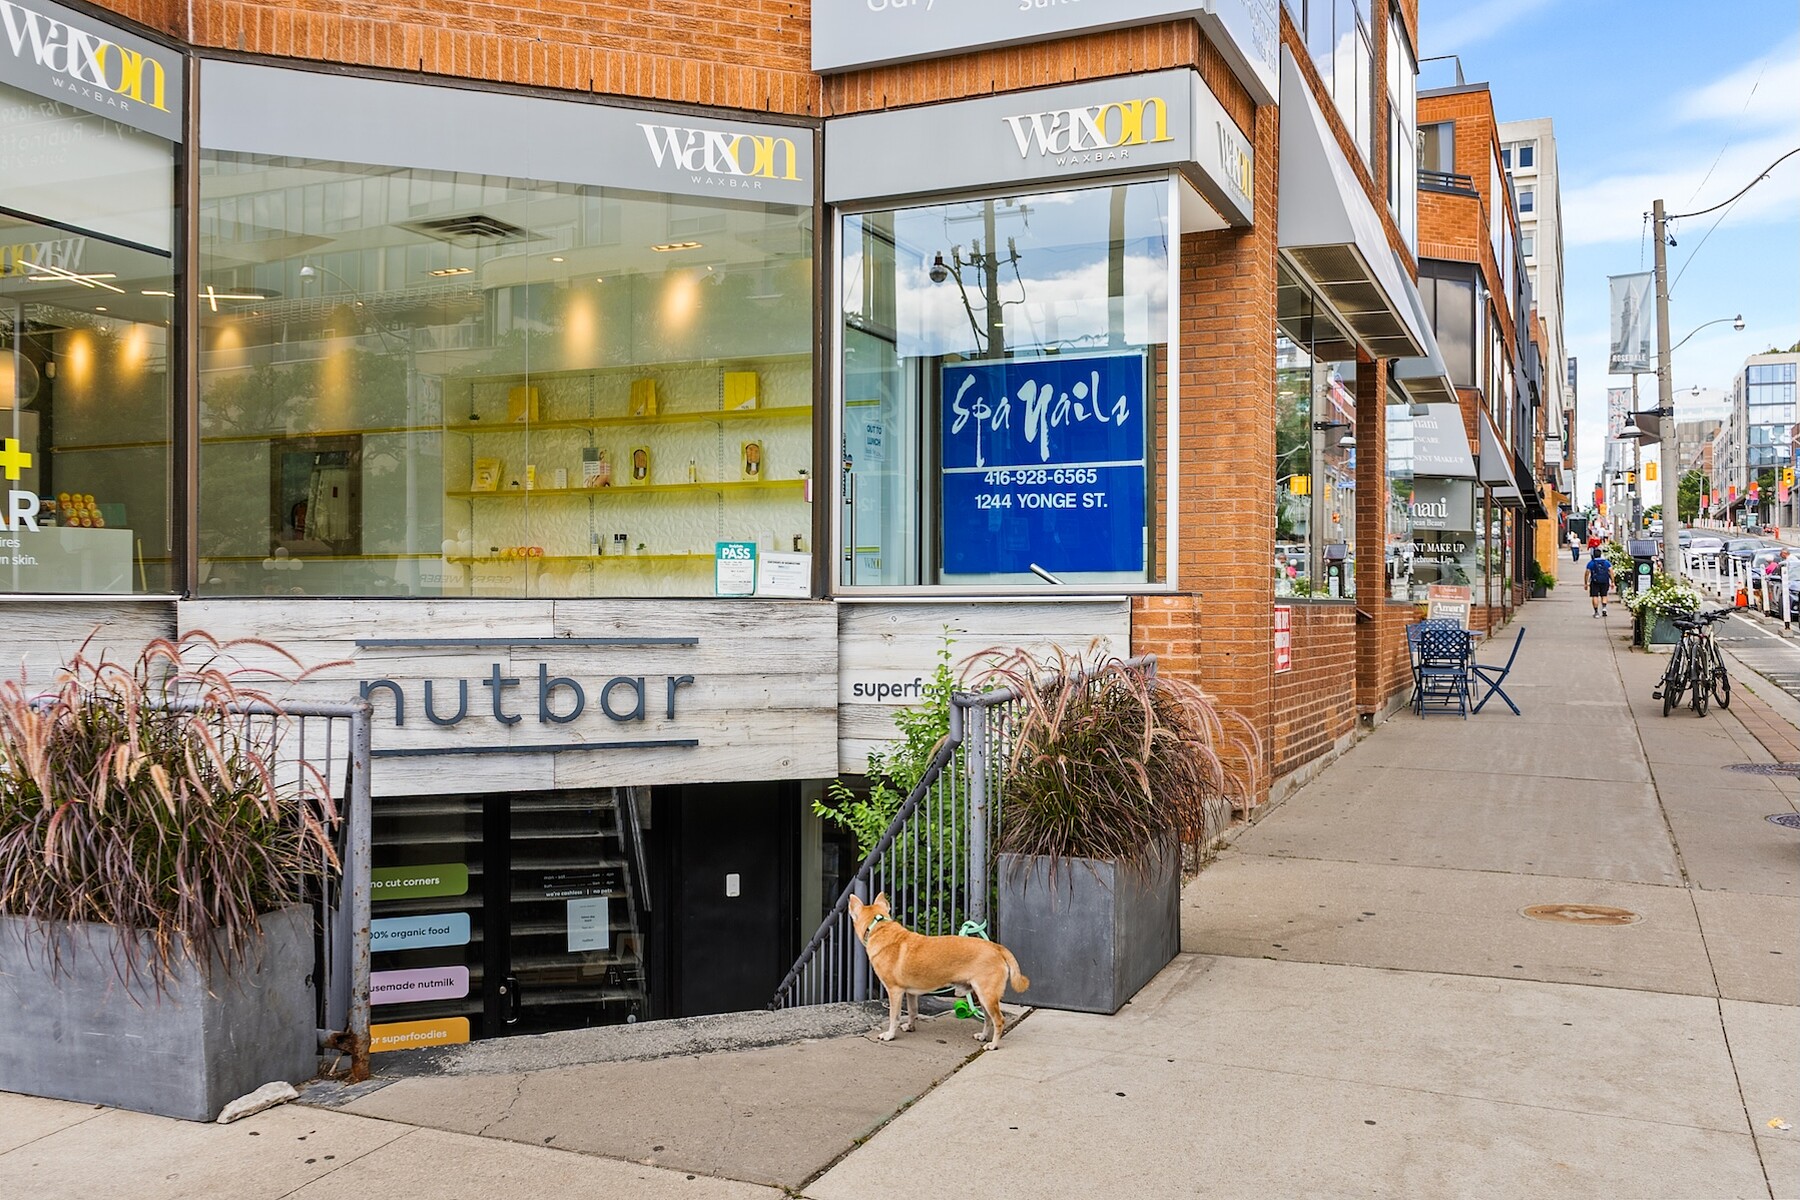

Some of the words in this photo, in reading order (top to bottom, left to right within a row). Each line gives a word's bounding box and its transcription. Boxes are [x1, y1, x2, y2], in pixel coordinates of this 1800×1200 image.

[52, 76, 130, 111] WAXBAR
[1056, 150, 1129, 166] WAXBAR
[691, 175, 762, 189] WAXBAR
[1612, 354, 1646, 363] ROSEDALE
[951, 374, 1010, 467] Spa
[1017, 371, 1130, 462] Nails
[867, 424, 876, 434] OUT
[876, 425, 882, 435] TO
[867, 437, 882, 446] LUNCH
[984, 469, 1097, 485] 416-928-6565
[975, 494, 1012, 509] 1244
[1017, 493, 1076, 508] YONGE
[1083, 493, 1108, 508] ST.
[722, 547, 751, 559] PASS
[1427, 542, 1452, 553] MAKE
[1453, 543, 1465, 553] UP
[12, 554, 38, 566] skin.
[360, 664, 694, 726] nutbar
[853, 677, 960, 701] superfoo
[370, 881, 383, 889] no
[385, 879, 401, 888] cut
[403, 877, 440, 887] corners
[601, 888, 613, 896] pets
[391, 927, 426, 940] organic
[428, 926, 450, 936] food
[418, 978, 455, 989] nutmilk
[382, 1029, 447, 1044] superfoodies
